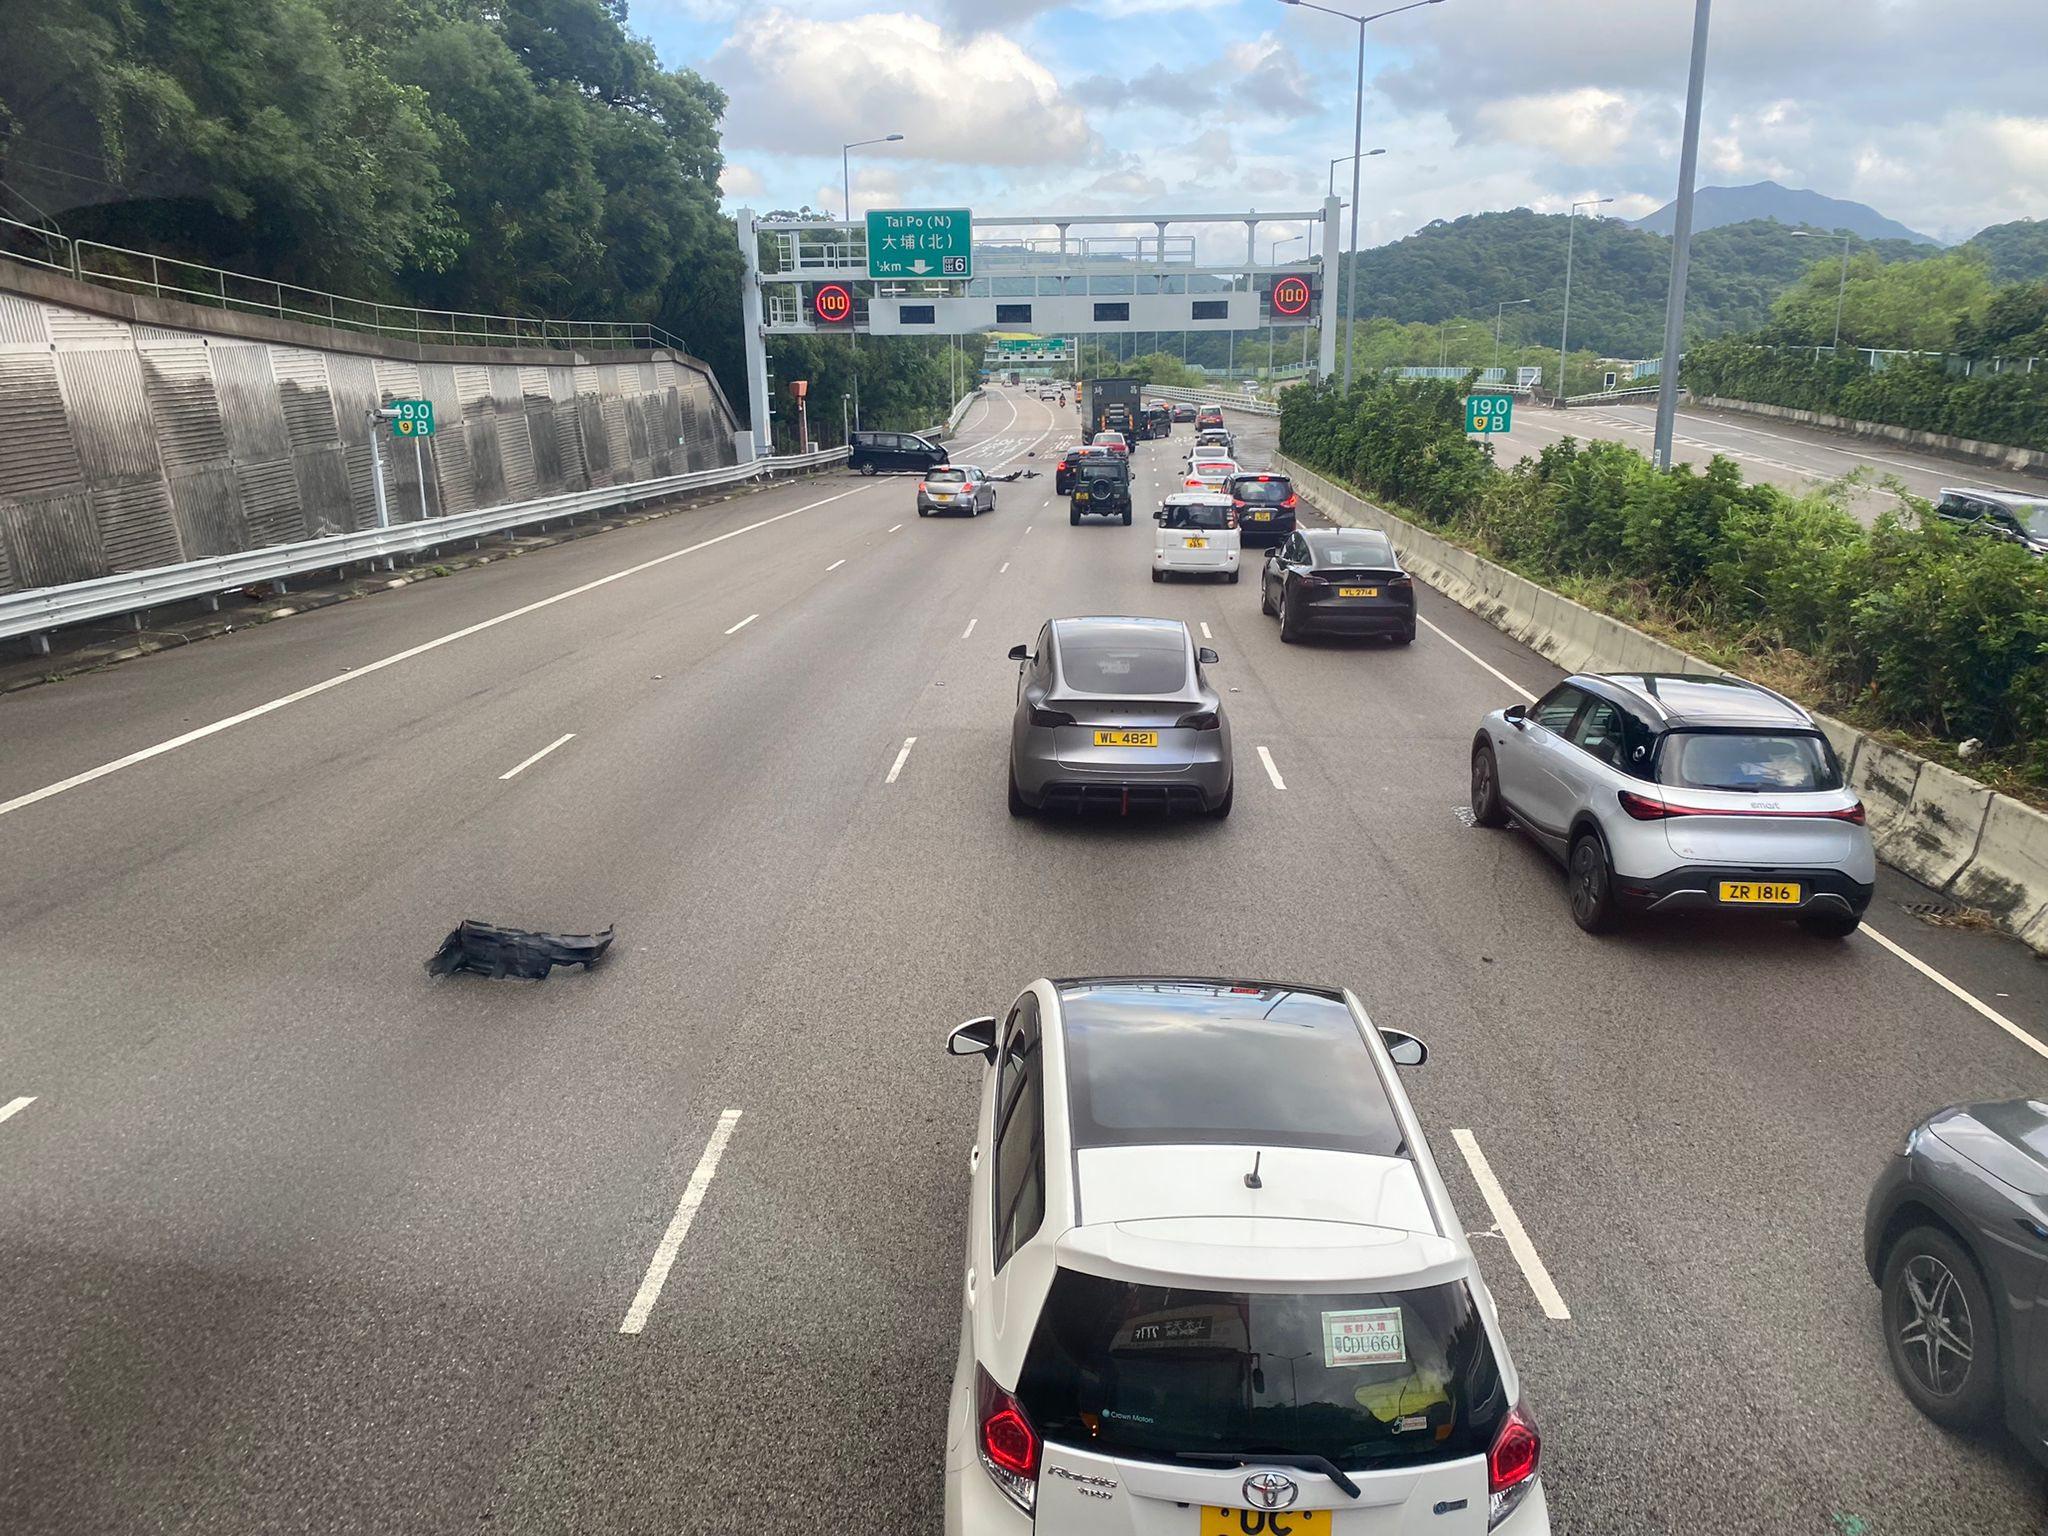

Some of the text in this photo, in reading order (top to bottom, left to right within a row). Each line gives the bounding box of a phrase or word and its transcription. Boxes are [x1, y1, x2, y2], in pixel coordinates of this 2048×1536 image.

[885, 215, 951, 229] Tai Po (N)
[955, 258, 965, 271] 6
[1279, 288, 1304, 302] 100
[821, 296, 845, 310] 100
[1471, 399, 1508, 415] 19.0
[402, 420, 429, 435] 9 B
[1477, 416, 1504, 431] 9 B
[1100, 732, 1153, 745] WL 4821
[1729, 885, 1791, 900] ZR 1816
[1110, 1411, 1154, 1424] Crown Motors
